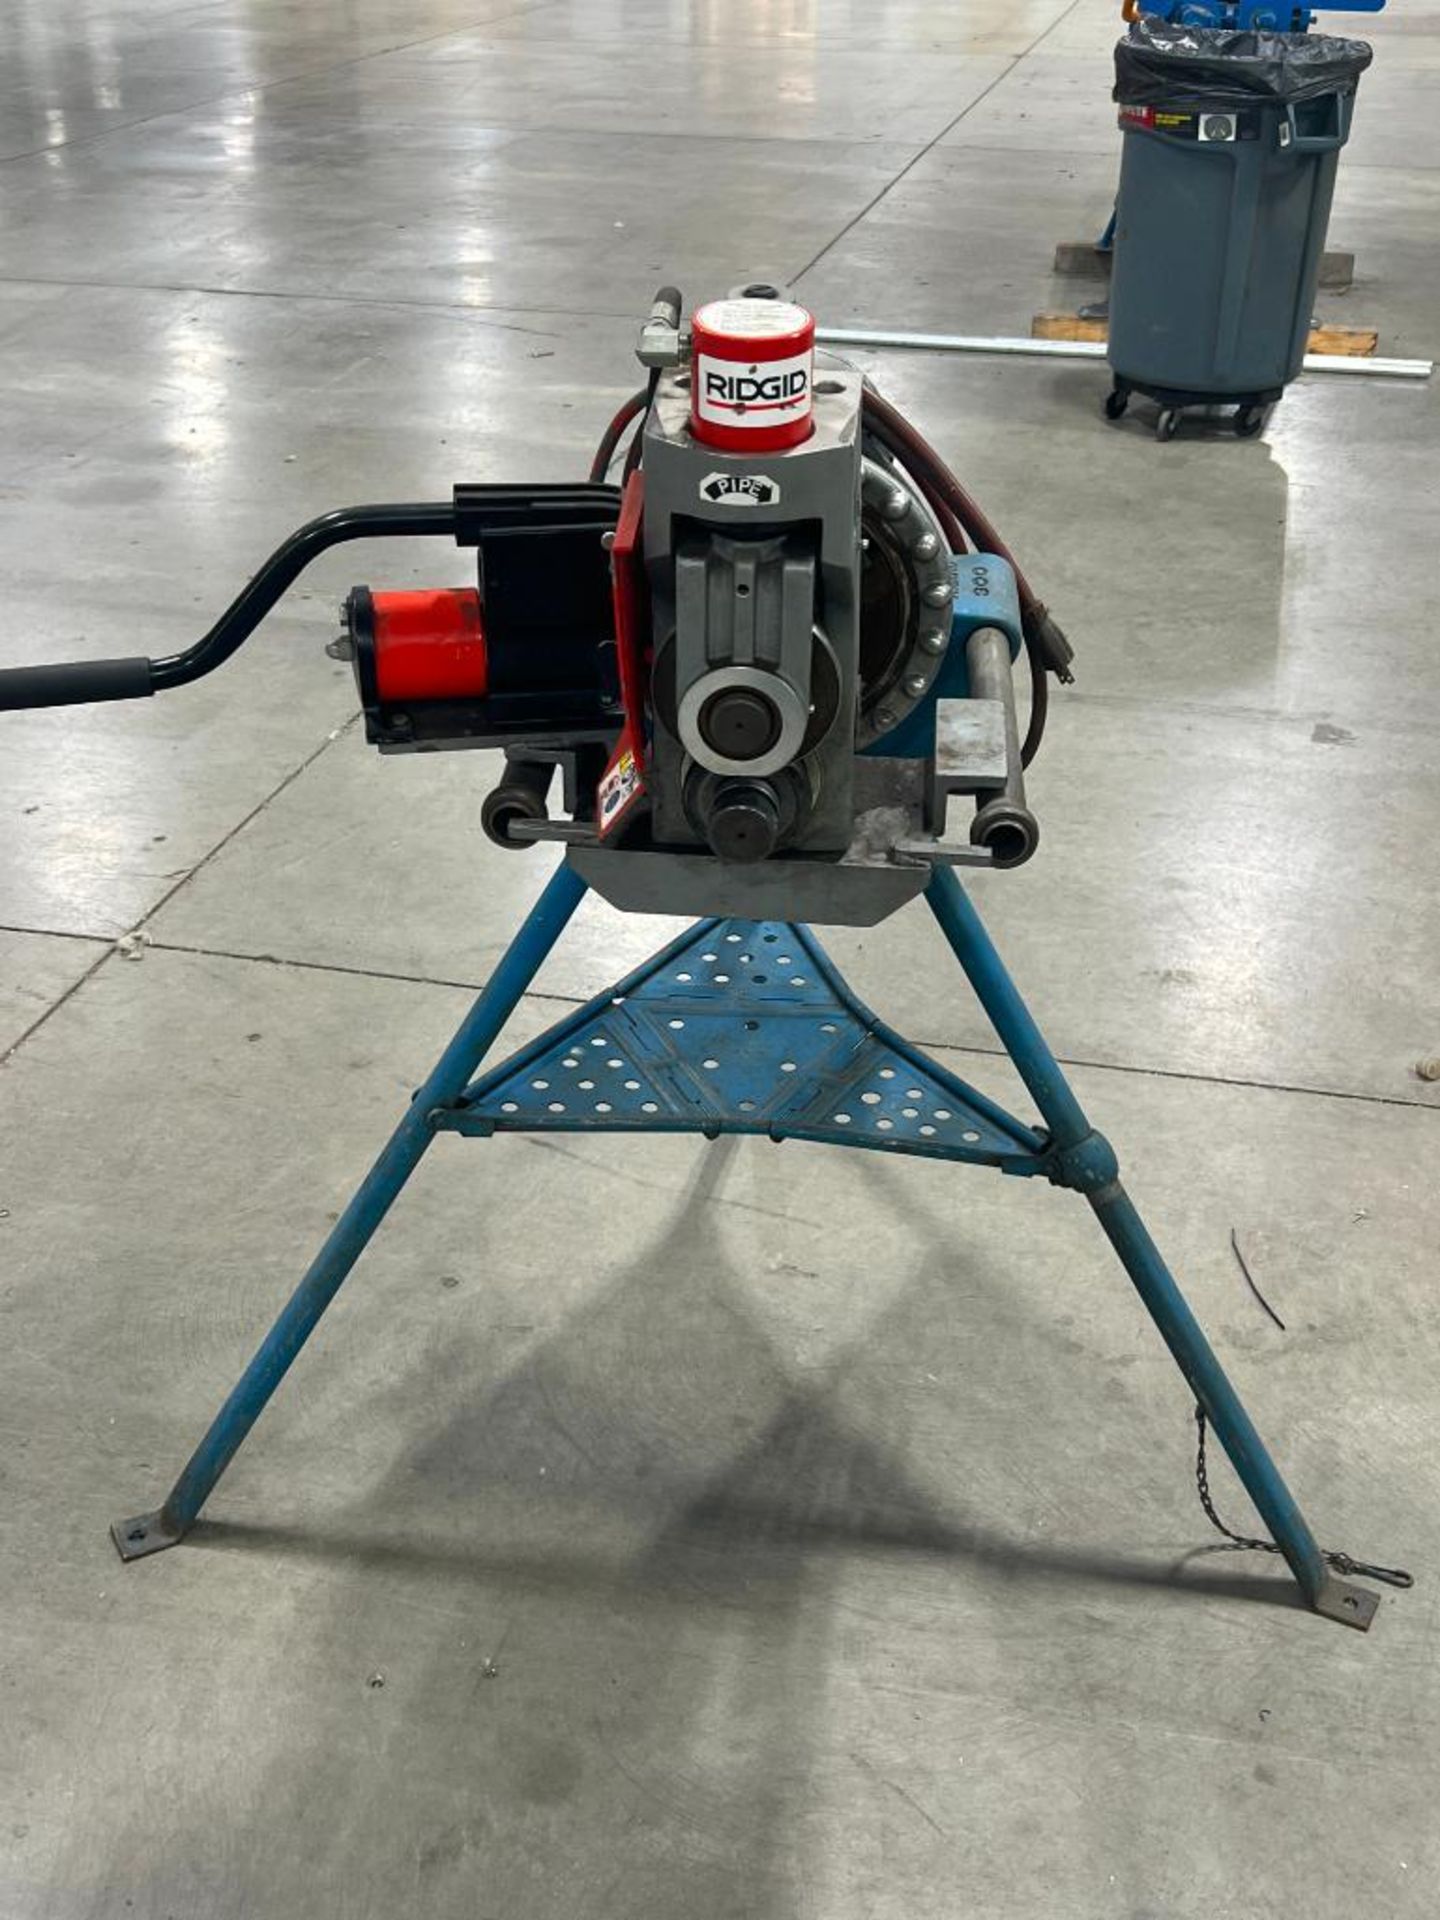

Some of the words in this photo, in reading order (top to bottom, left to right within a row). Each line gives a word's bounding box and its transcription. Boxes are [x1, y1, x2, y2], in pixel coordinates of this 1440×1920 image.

[706, 370, 806, 401] RIDGID
[717, 478, 762, 497] PIPE
[972, 567, 989, 597] 300
